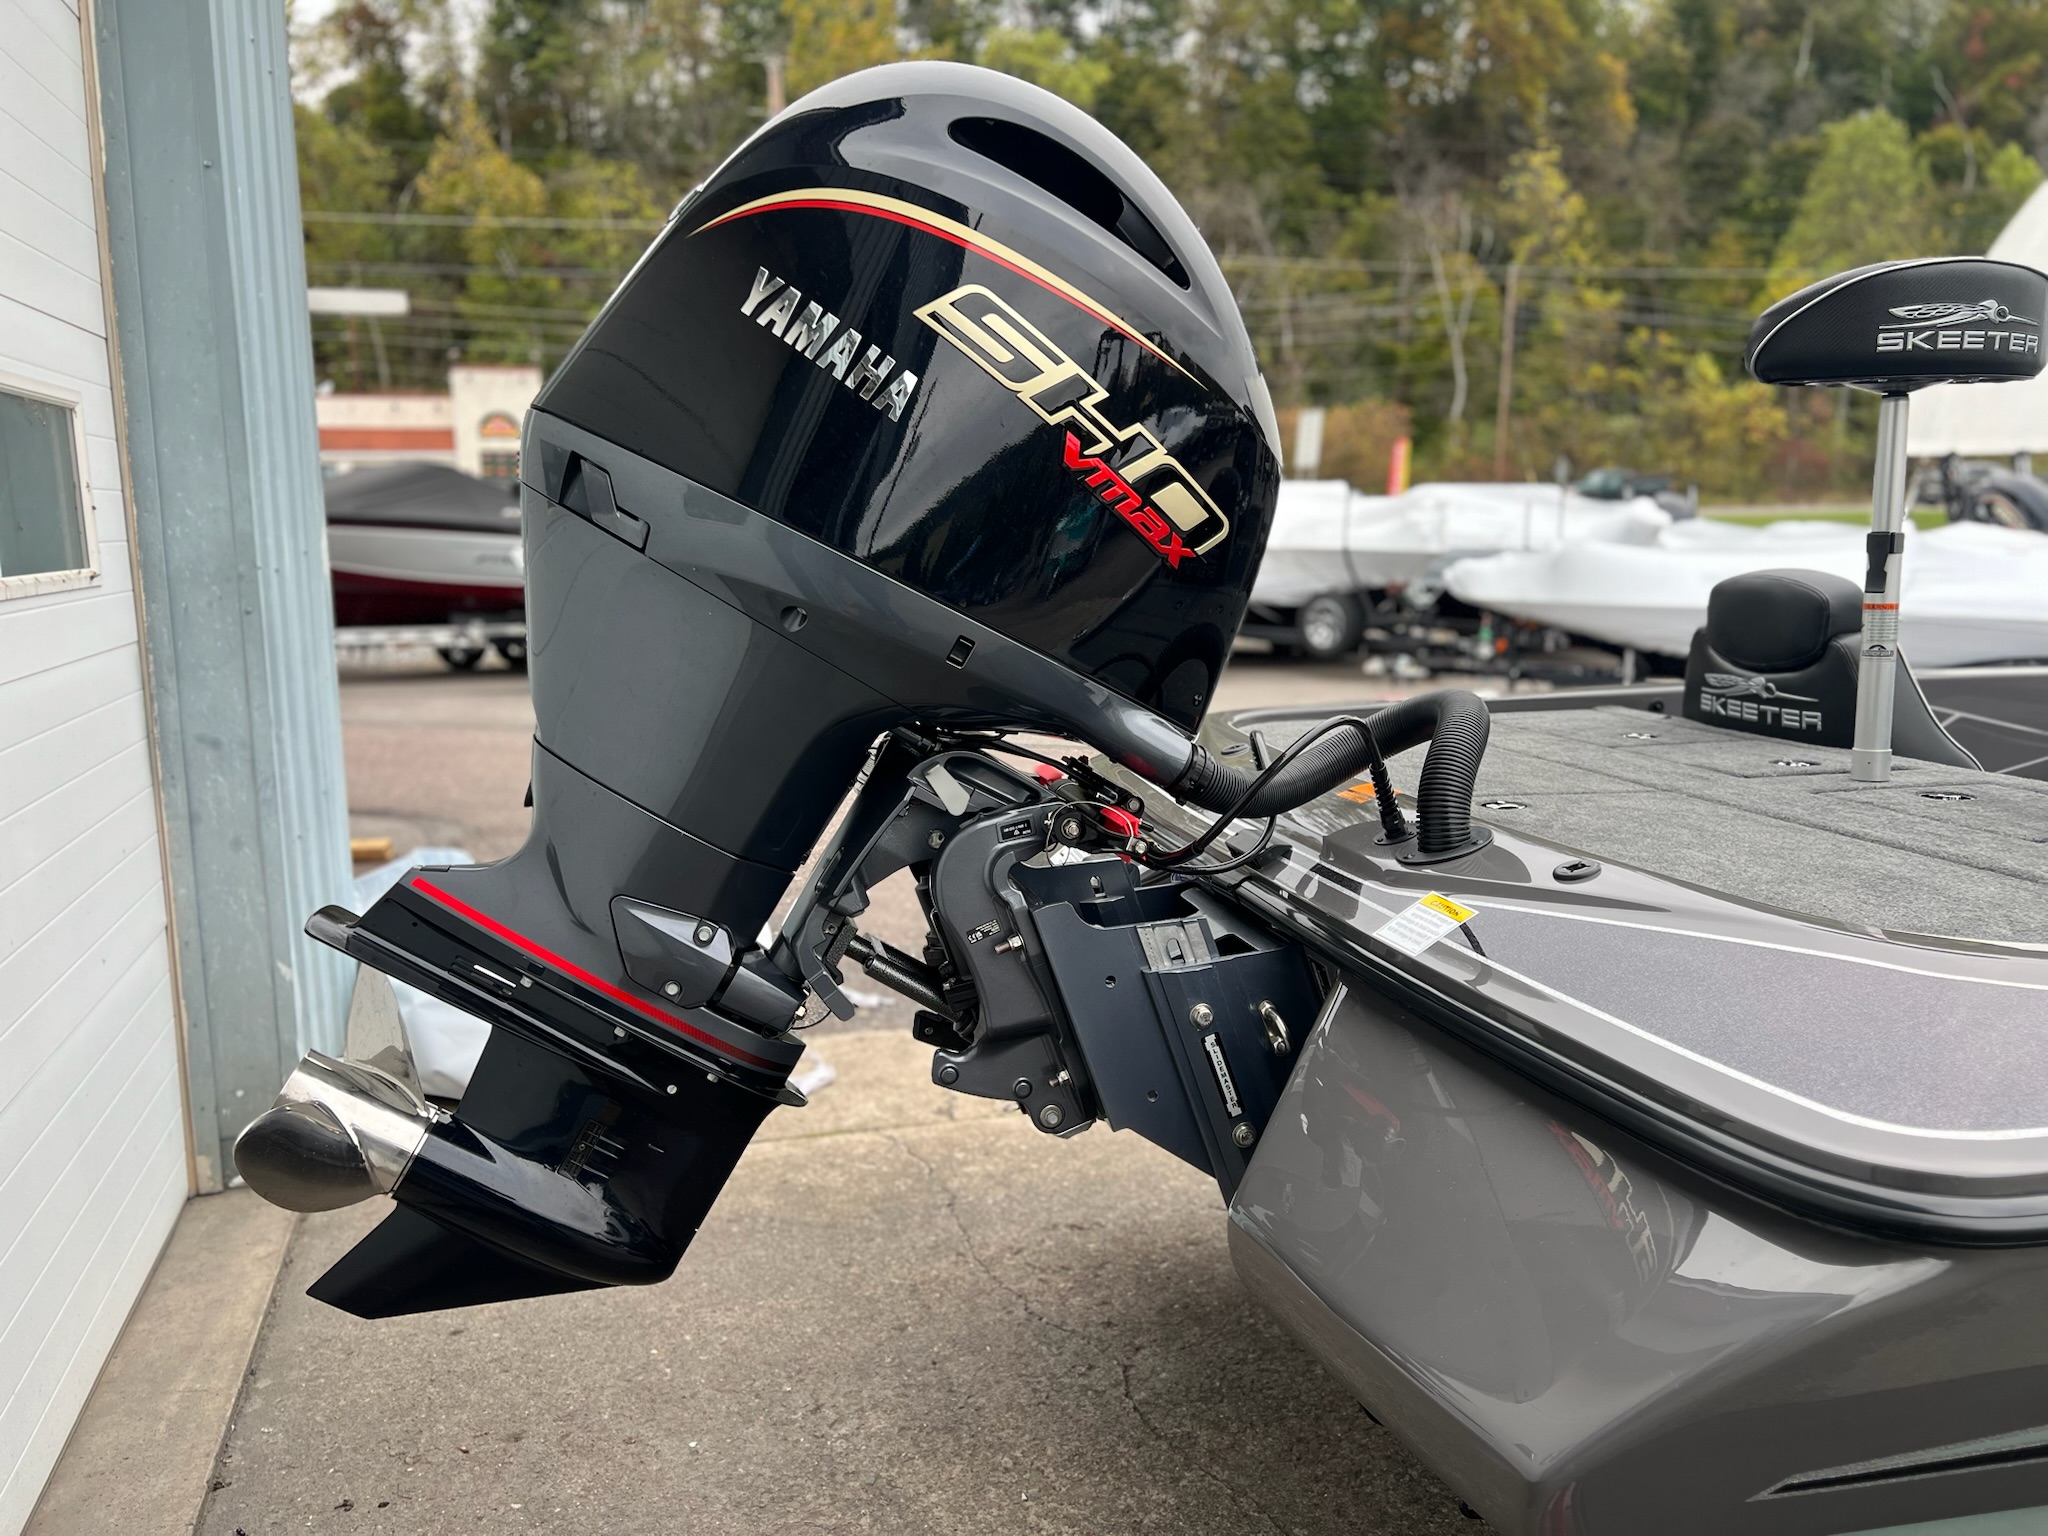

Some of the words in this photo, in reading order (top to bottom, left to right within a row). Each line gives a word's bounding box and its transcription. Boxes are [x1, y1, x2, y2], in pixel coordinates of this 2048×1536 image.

[739, 266, 918, 422] YAMAHA
[1875, 330, 2040, 354] SKEETER
[913, 283, 1230, 556] SHO
[1700, 692, 1822, 732] SKEETER
[1430, 900, 1462, 917] CAUTION
